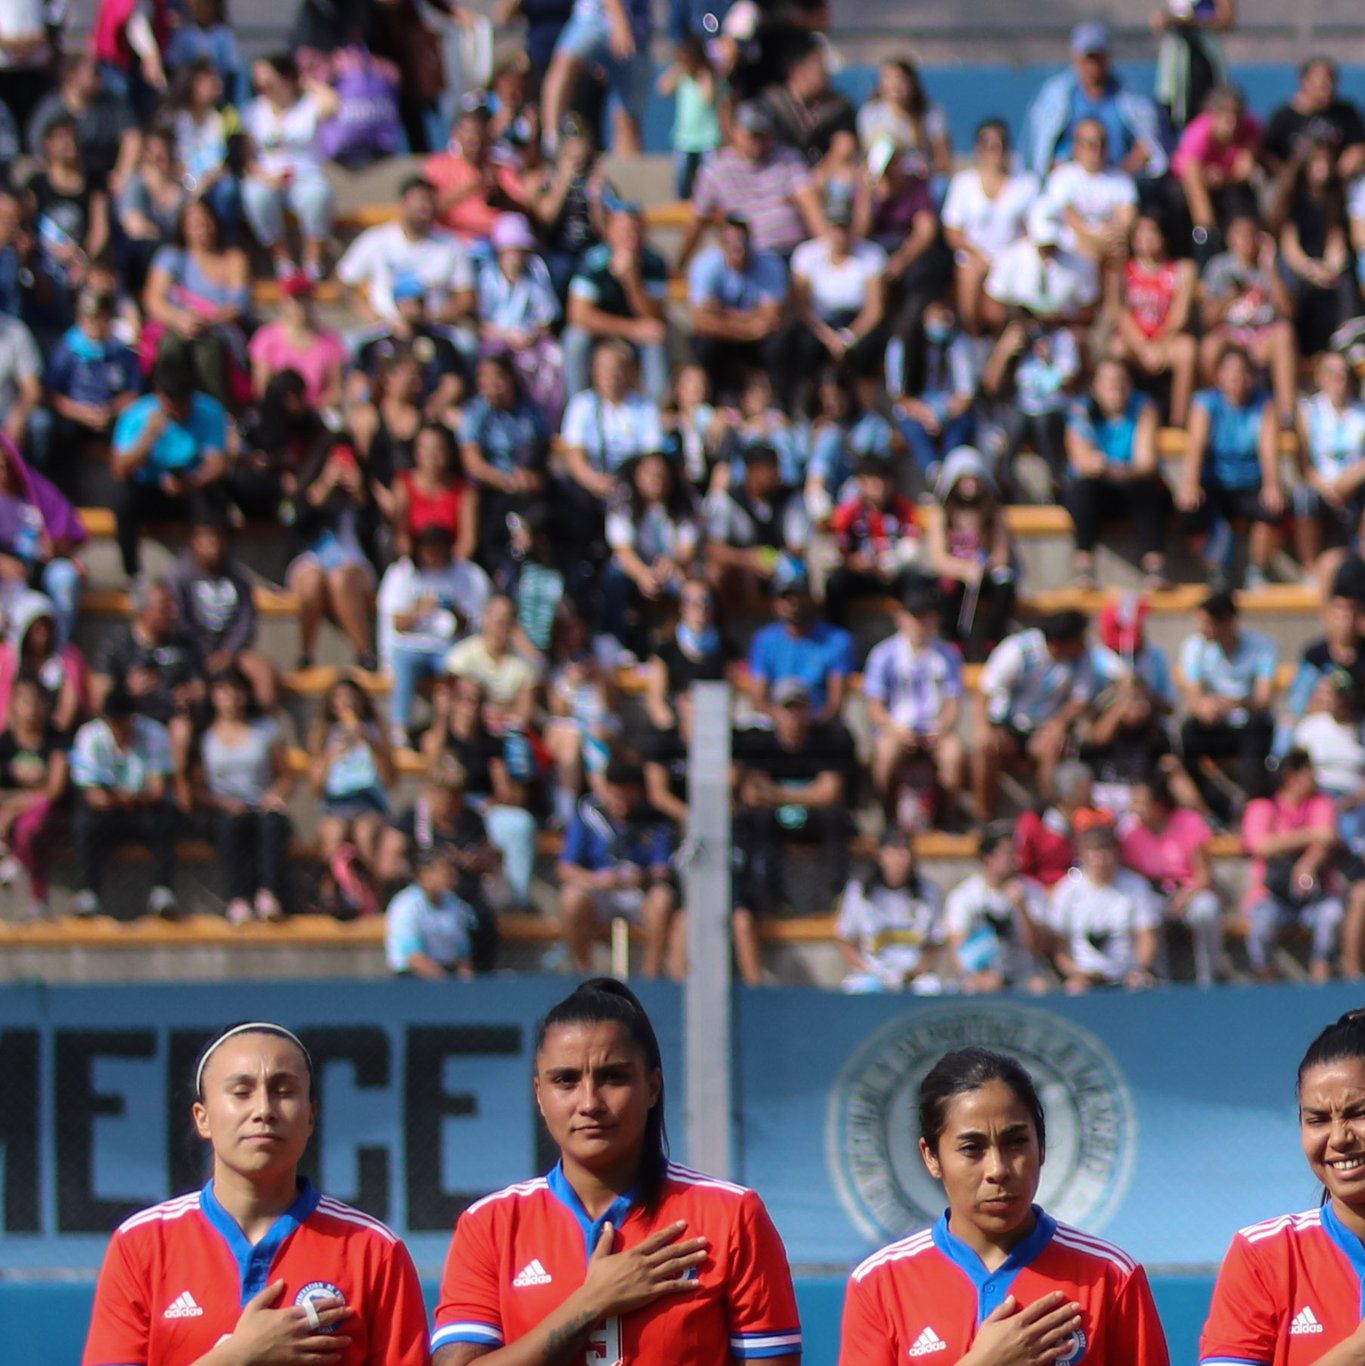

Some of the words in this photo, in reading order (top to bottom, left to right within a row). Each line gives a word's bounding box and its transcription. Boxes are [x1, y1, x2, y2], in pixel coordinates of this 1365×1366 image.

[513, 1273, 553, 1287] adidas
[164, 1306, 204, 1320] adidas
[1288, 1321, 1323, 1334] adidas
[909, 1340, 947, 1357] adidas
